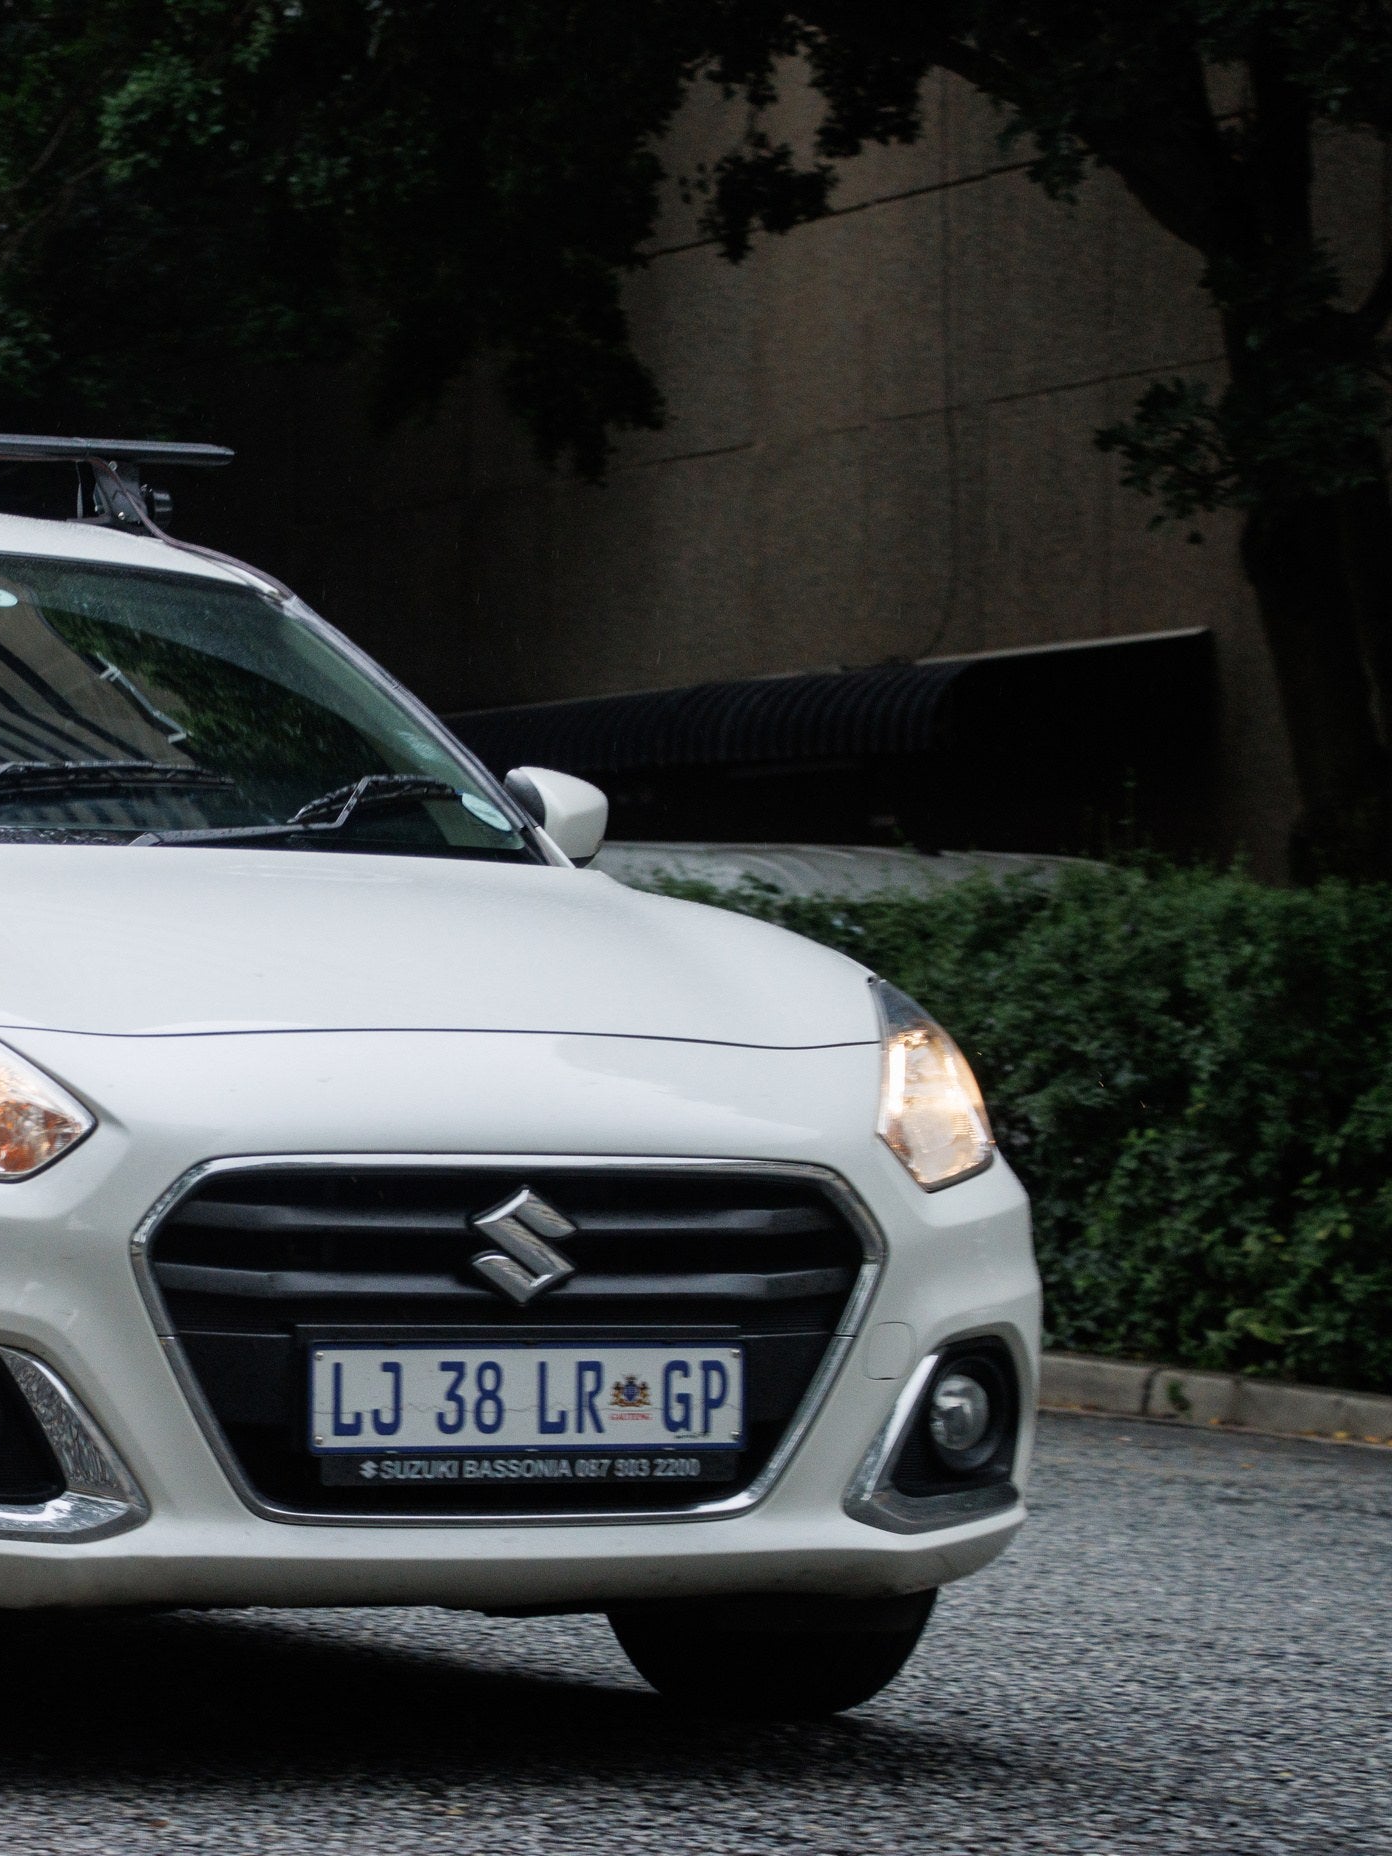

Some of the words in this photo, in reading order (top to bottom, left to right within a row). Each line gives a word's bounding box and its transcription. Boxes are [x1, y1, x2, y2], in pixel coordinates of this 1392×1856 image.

[332, 1361, 403, 1437] LJ
[436, 1360, 505, 1435] 38
[537, 1360, 605, 1435] LR
[662, 1359, 729, 1435] GP
[379, 1460, 459, 1480] SUZUKI
[463, 1459, 573, 1479] BASSONIA
